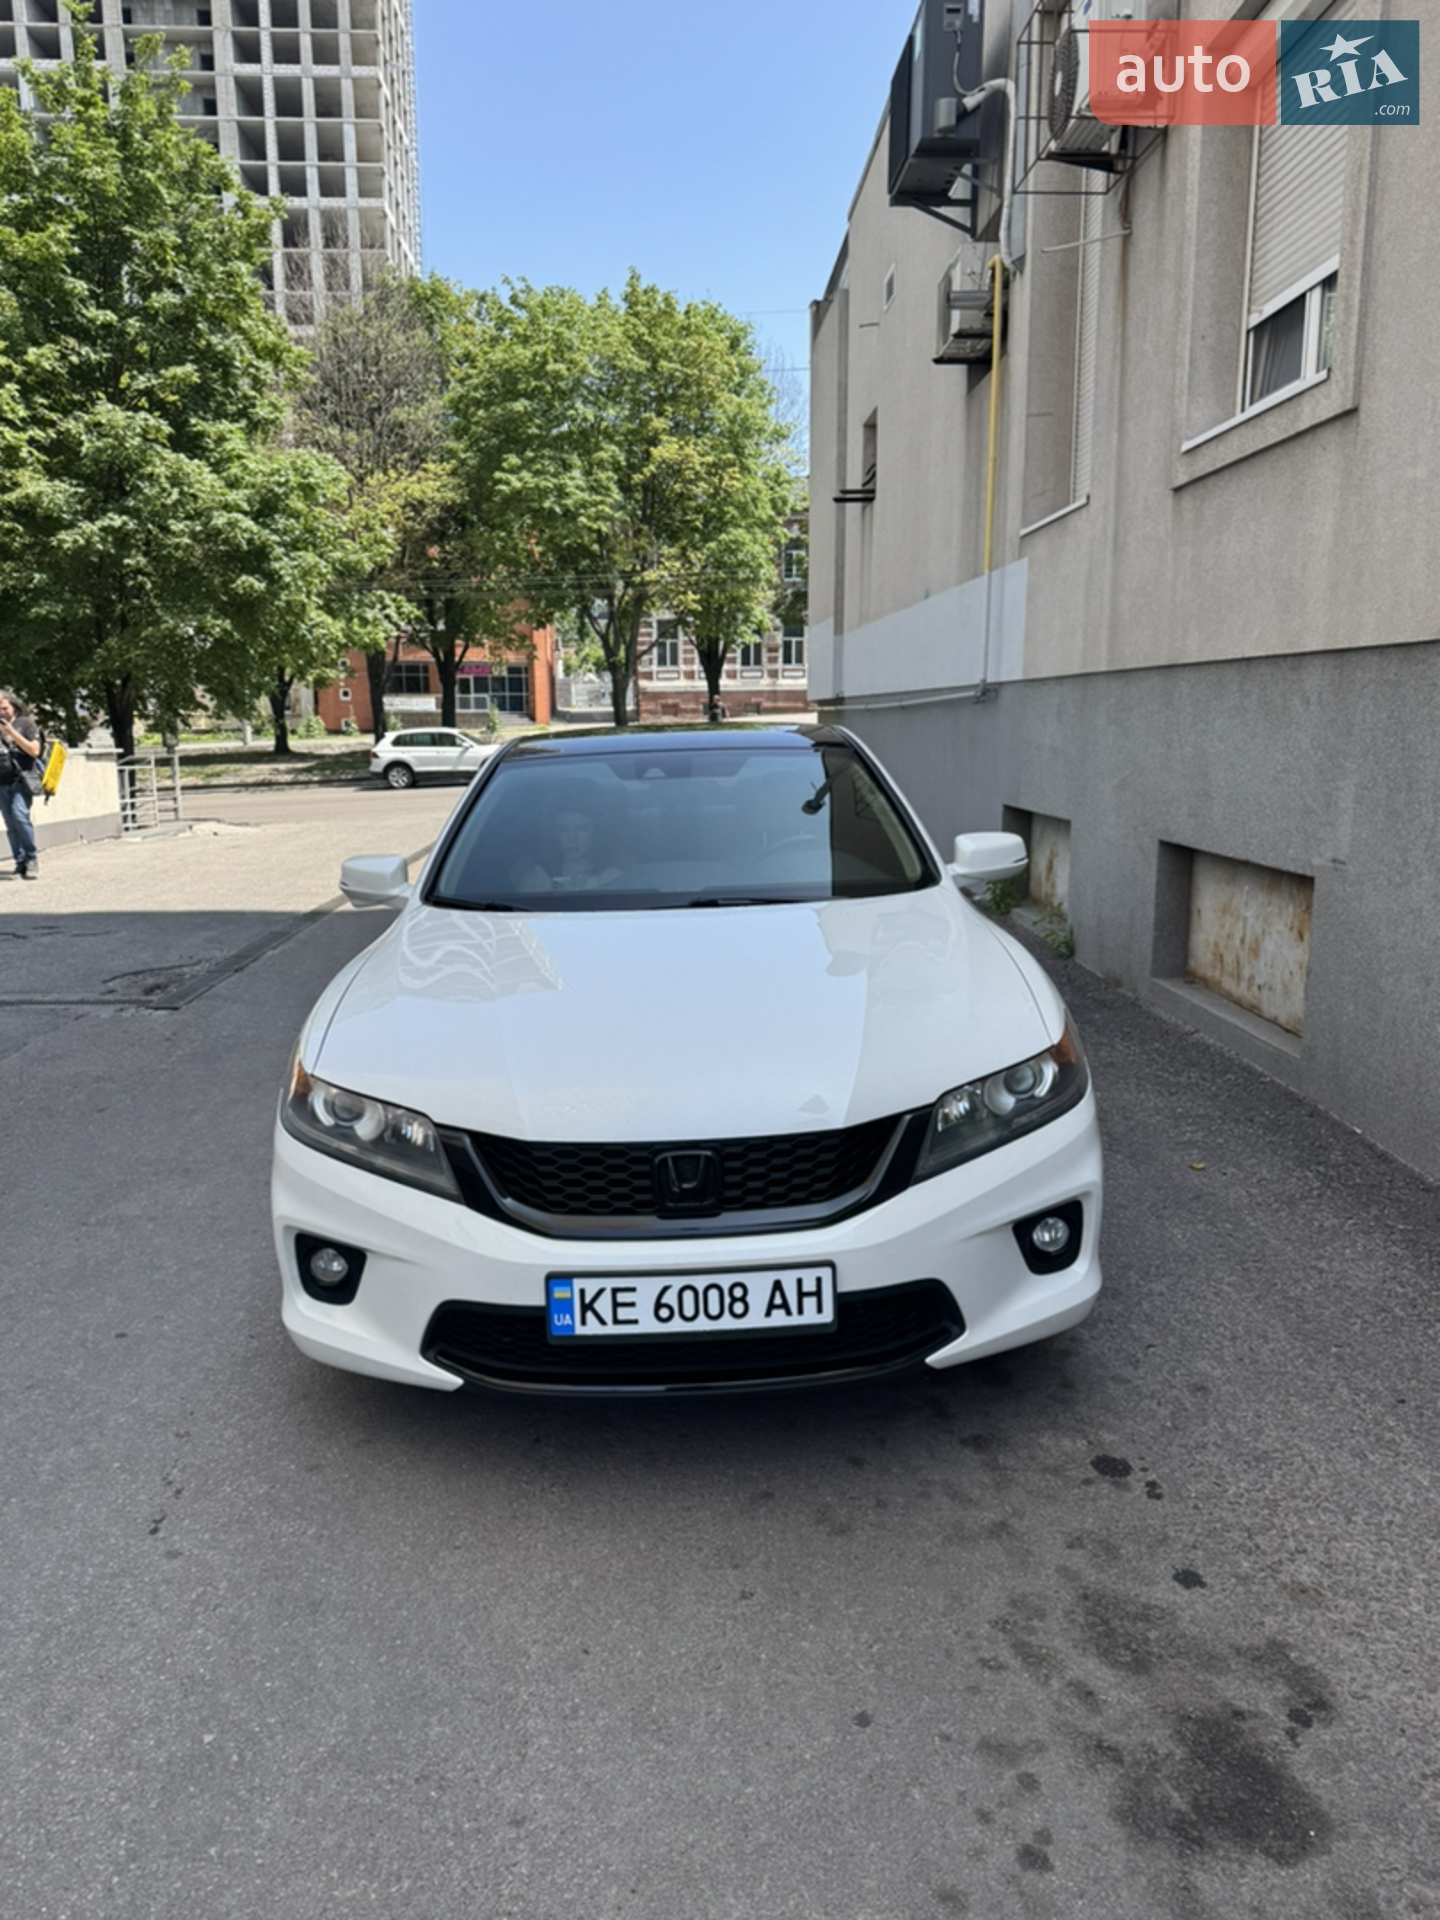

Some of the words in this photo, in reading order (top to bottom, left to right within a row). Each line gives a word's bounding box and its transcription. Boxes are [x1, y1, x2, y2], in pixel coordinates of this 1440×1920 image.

[579, 1287, 639, 1327] KE
[653, 1281, 750, 1324] 6008
[764, 1276, 823, 1318] AH
[554, 1314, 573, 1326] UA
